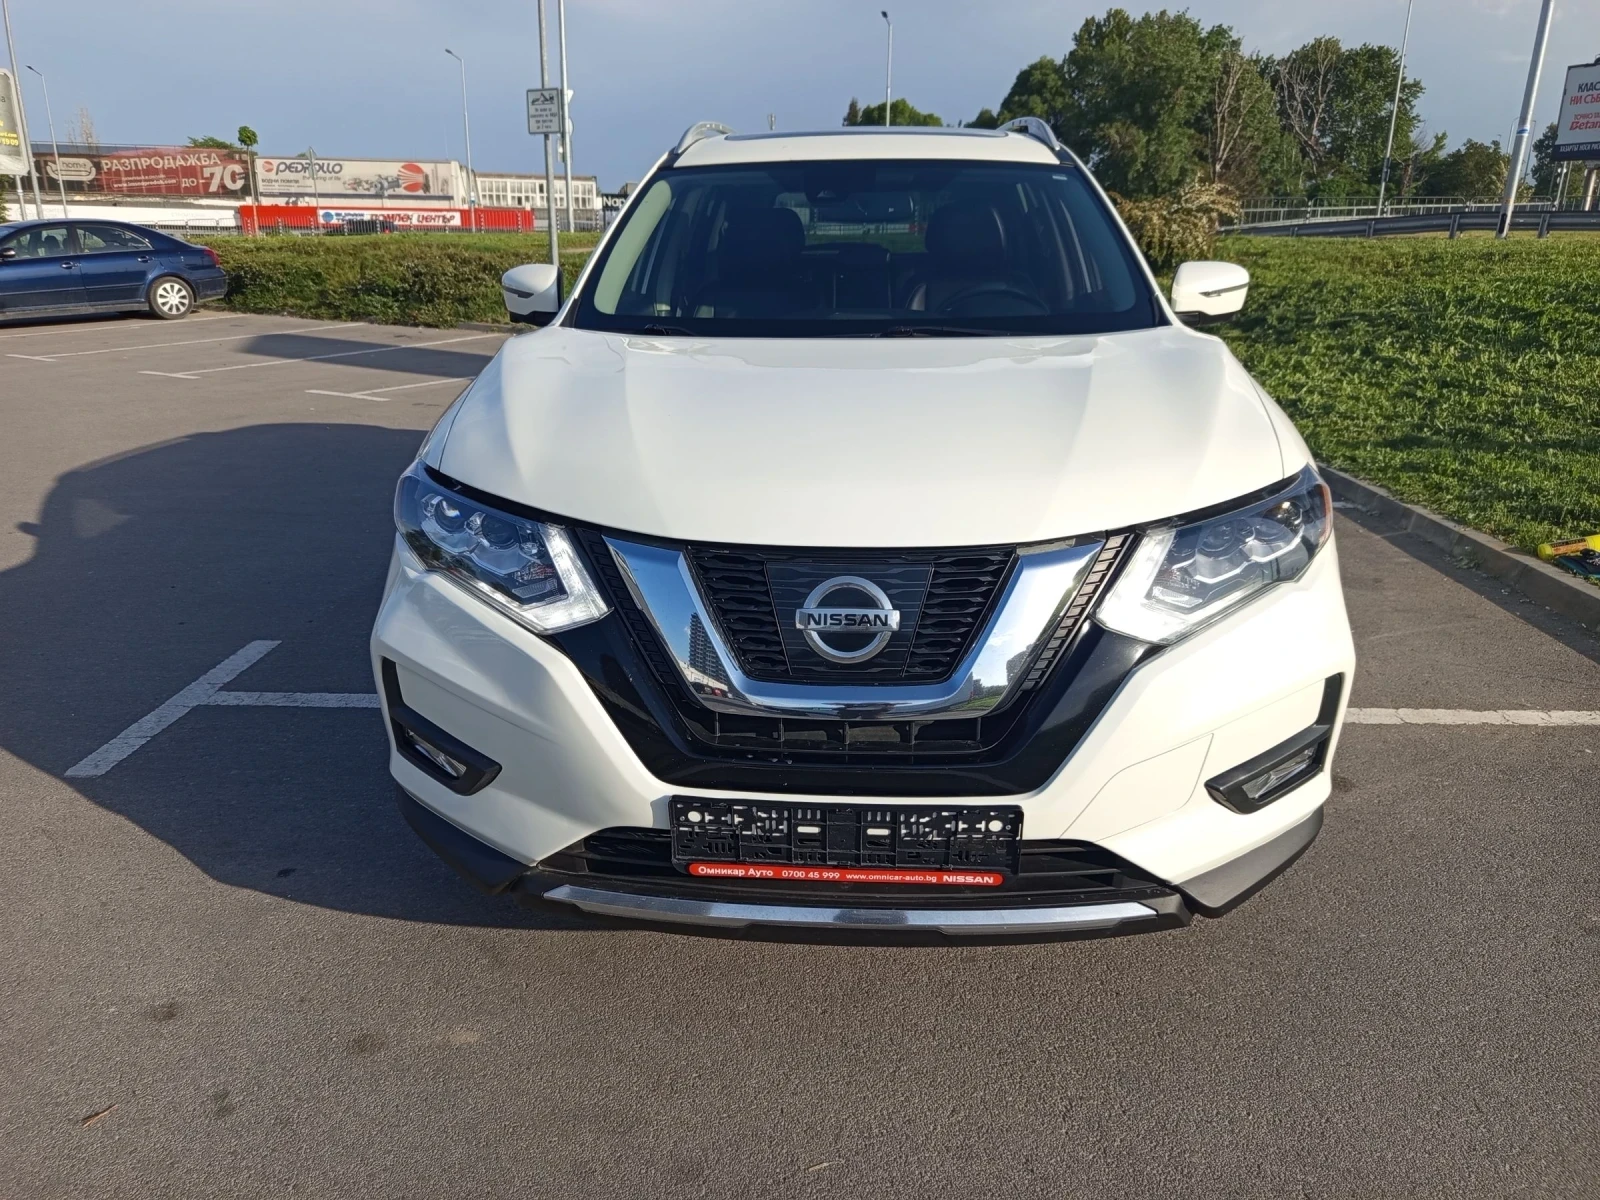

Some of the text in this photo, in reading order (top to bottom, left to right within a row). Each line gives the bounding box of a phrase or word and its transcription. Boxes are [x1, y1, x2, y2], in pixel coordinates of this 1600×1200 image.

[101, 152, 221, 172] РАЗПРОДАЖБА
[807, 613, 888, 627] NISSAN
[698, 866, 840, 880] Омникар Ауто 0700 45 999
[846, 873, 937, 883] www.omnicar-auto.bg
[943, 875, 994, 884] NISSAN
